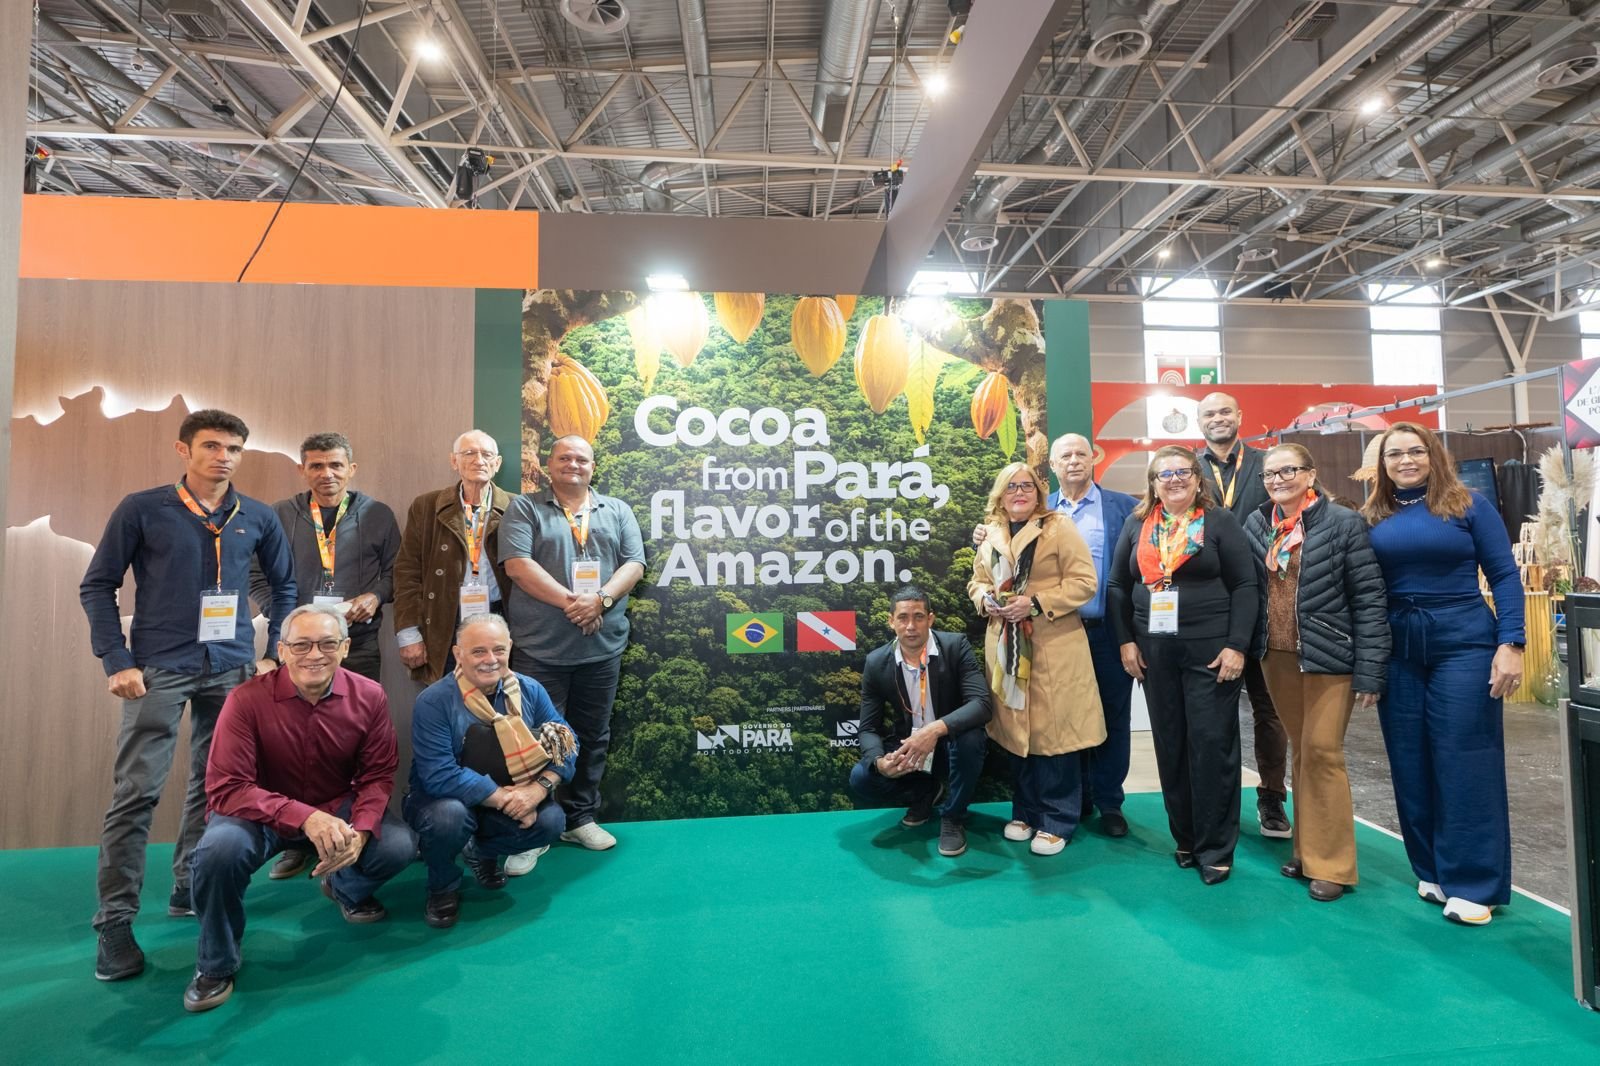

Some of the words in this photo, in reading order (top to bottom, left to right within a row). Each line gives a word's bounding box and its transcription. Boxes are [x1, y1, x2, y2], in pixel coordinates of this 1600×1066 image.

[633, 395, 831, 447] Cocoa
[702, 455, 788, 491] from
[794, 444, 950, 509] Pará,
[650, 490, 820, 540] flavor
[825, 507, 866, 543] of
[870, 507, 931, 542] the
[657, 542, 912, 587] Amazon.
